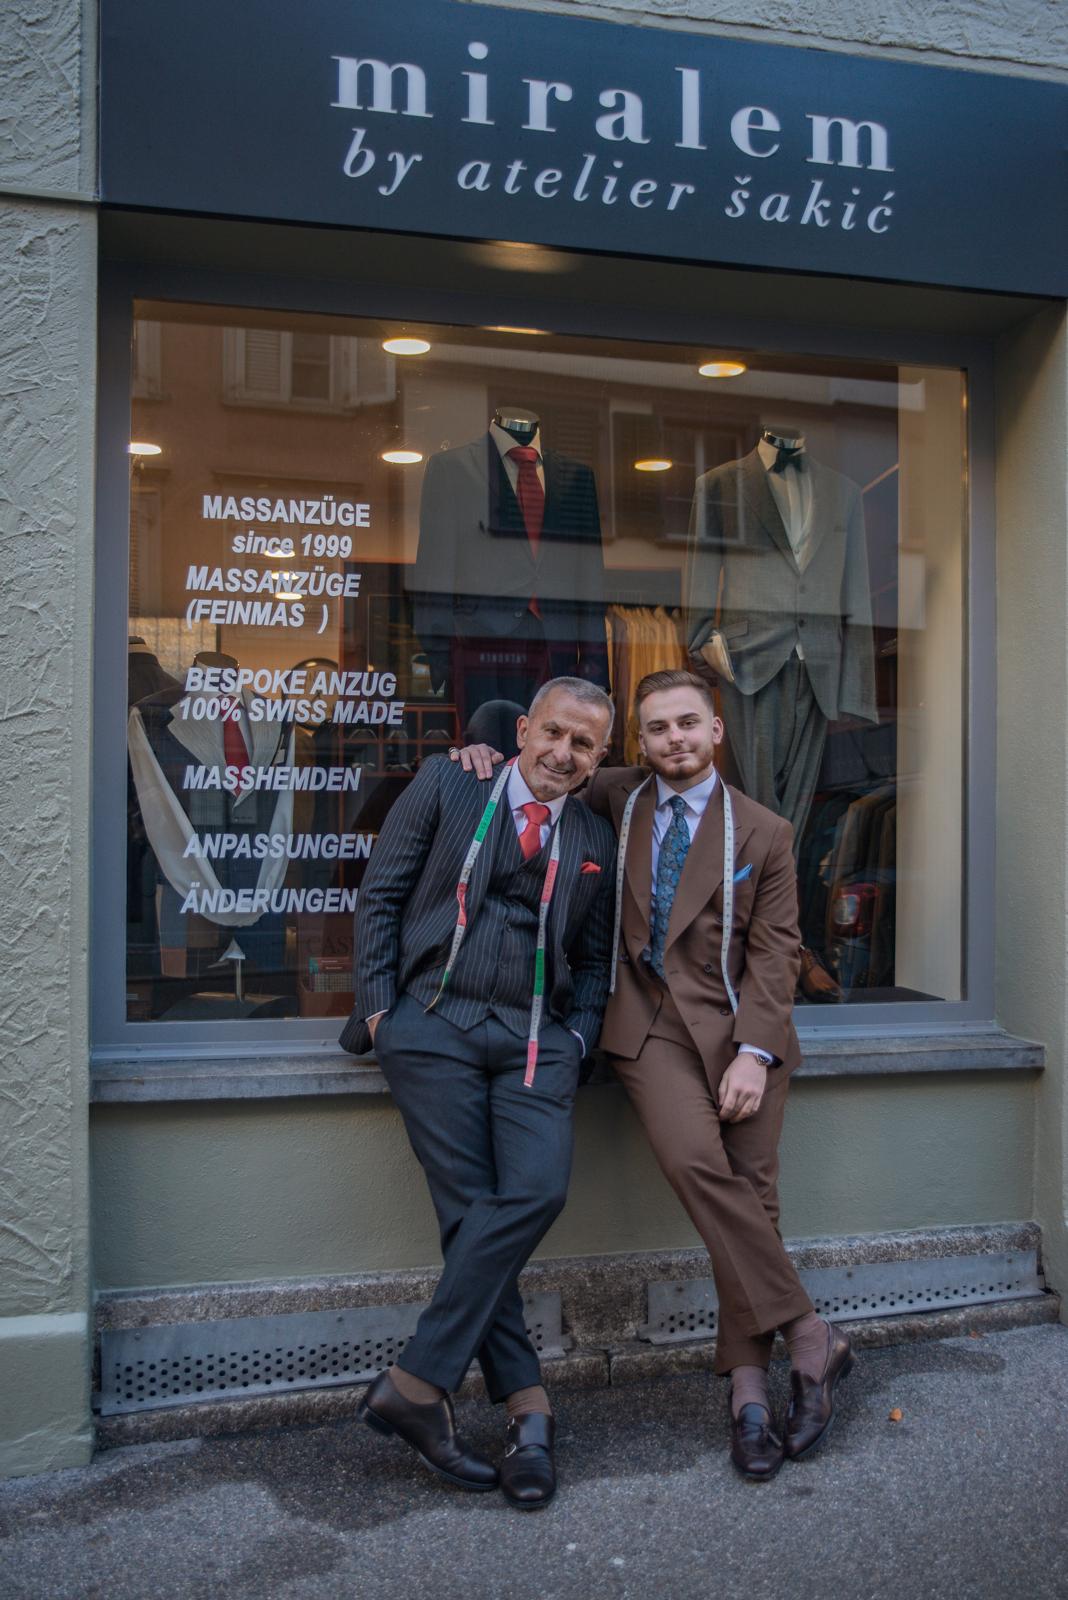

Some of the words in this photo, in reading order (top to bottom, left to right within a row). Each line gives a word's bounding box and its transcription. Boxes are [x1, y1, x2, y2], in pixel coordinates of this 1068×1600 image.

[331, 41, 894, 172] miralem
[343, 128, 421, 196] by
[457, 153, 696, 211] atelier
[724, 175, 895, 233] šakić
[203, 495, 370, 527] MASSANZÜGE
[232, 530, 294, 555] since
[301, 533, 353, 558] 1999
[186, 566, 361, 597] MASSANZÜGE
[185, 668, 306, 694] BESPOKE
[310, 671, 397, 696] ANZUG
[180, 698, 242, 722] 100%
[248, 699, 327, 723] SWISS
[332, 701, 405, 725] MADE
[183, 765, 361, 791] MASSHEMDEN
[183, 833, 373, 858] ANPASSUNGEN
[180, 882, 358, 913] ÄNDERUNGEN
